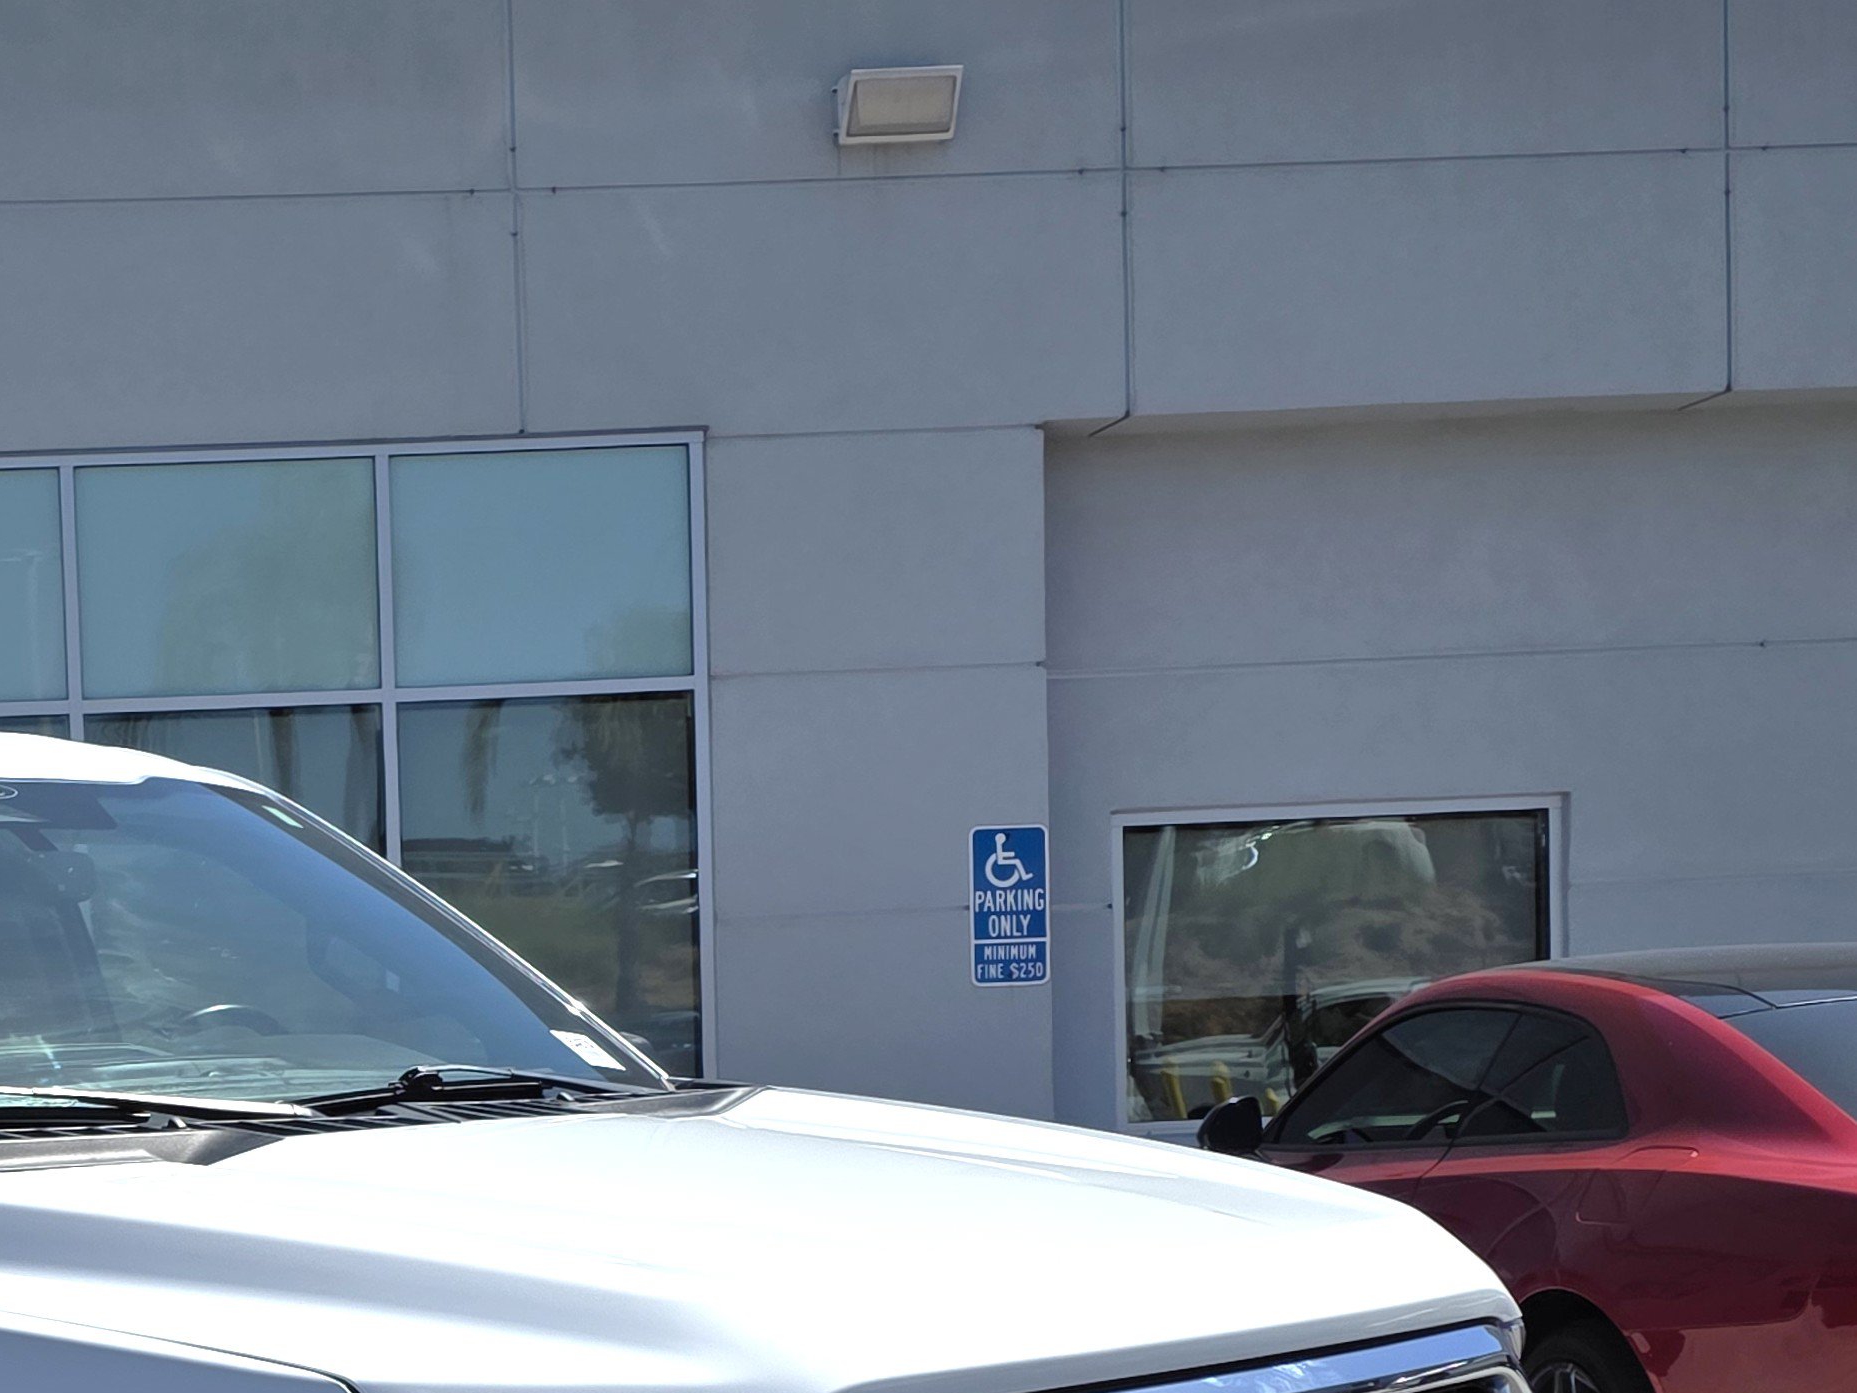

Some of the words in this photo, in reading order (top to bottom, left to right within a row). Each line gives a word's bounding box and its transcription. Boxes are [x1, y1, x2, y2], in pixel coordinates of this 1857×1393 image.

[975, 888, 1045, 912] PARKING
[988, 914, 1032, 937] ONLY
[983, 944, 1037, 960] MINIMUM
[977, 963, 1004, 979] FINE
[1009, 962, 1044, 979] $250
